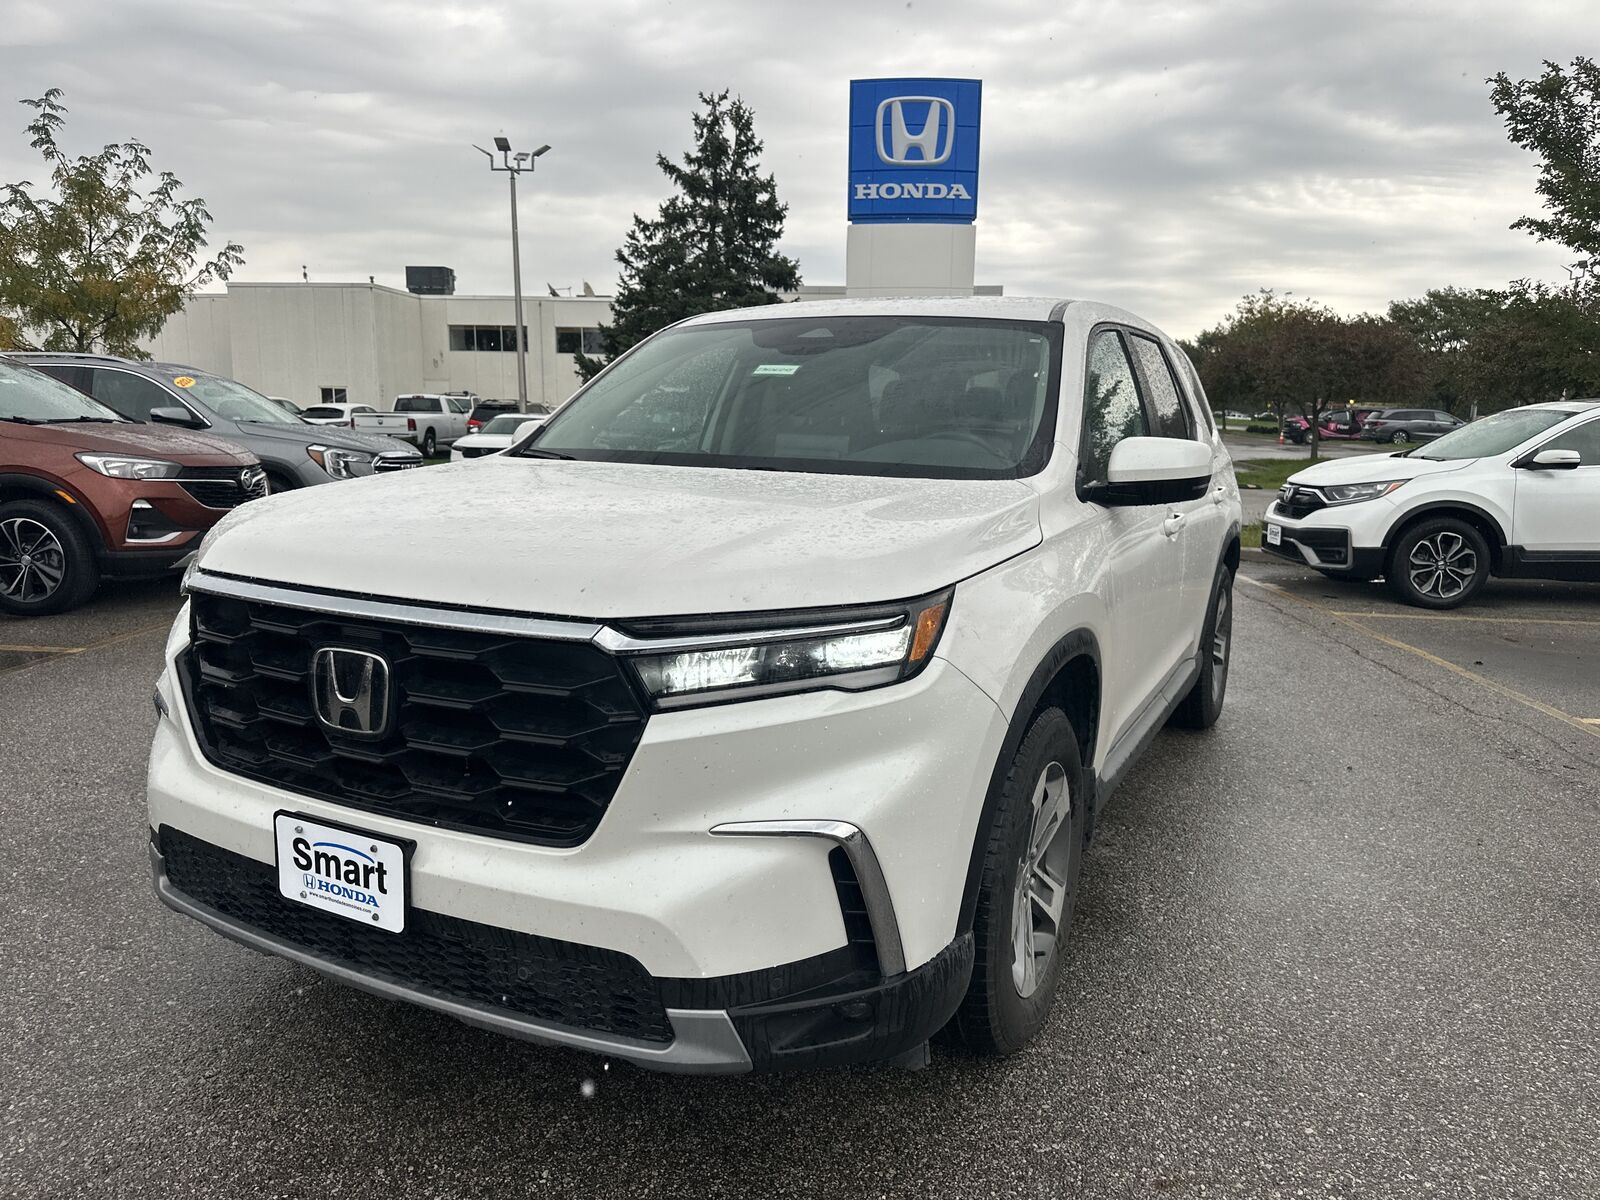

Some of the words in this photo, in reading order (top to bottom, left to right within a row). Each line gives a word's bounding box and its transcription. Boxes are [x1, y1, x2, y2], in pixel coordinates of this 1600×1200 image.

[854, 183, 972, 199] HONDA
[292, 837, 388, 895] Smart
[317, 879, 380, 908] HONDA
